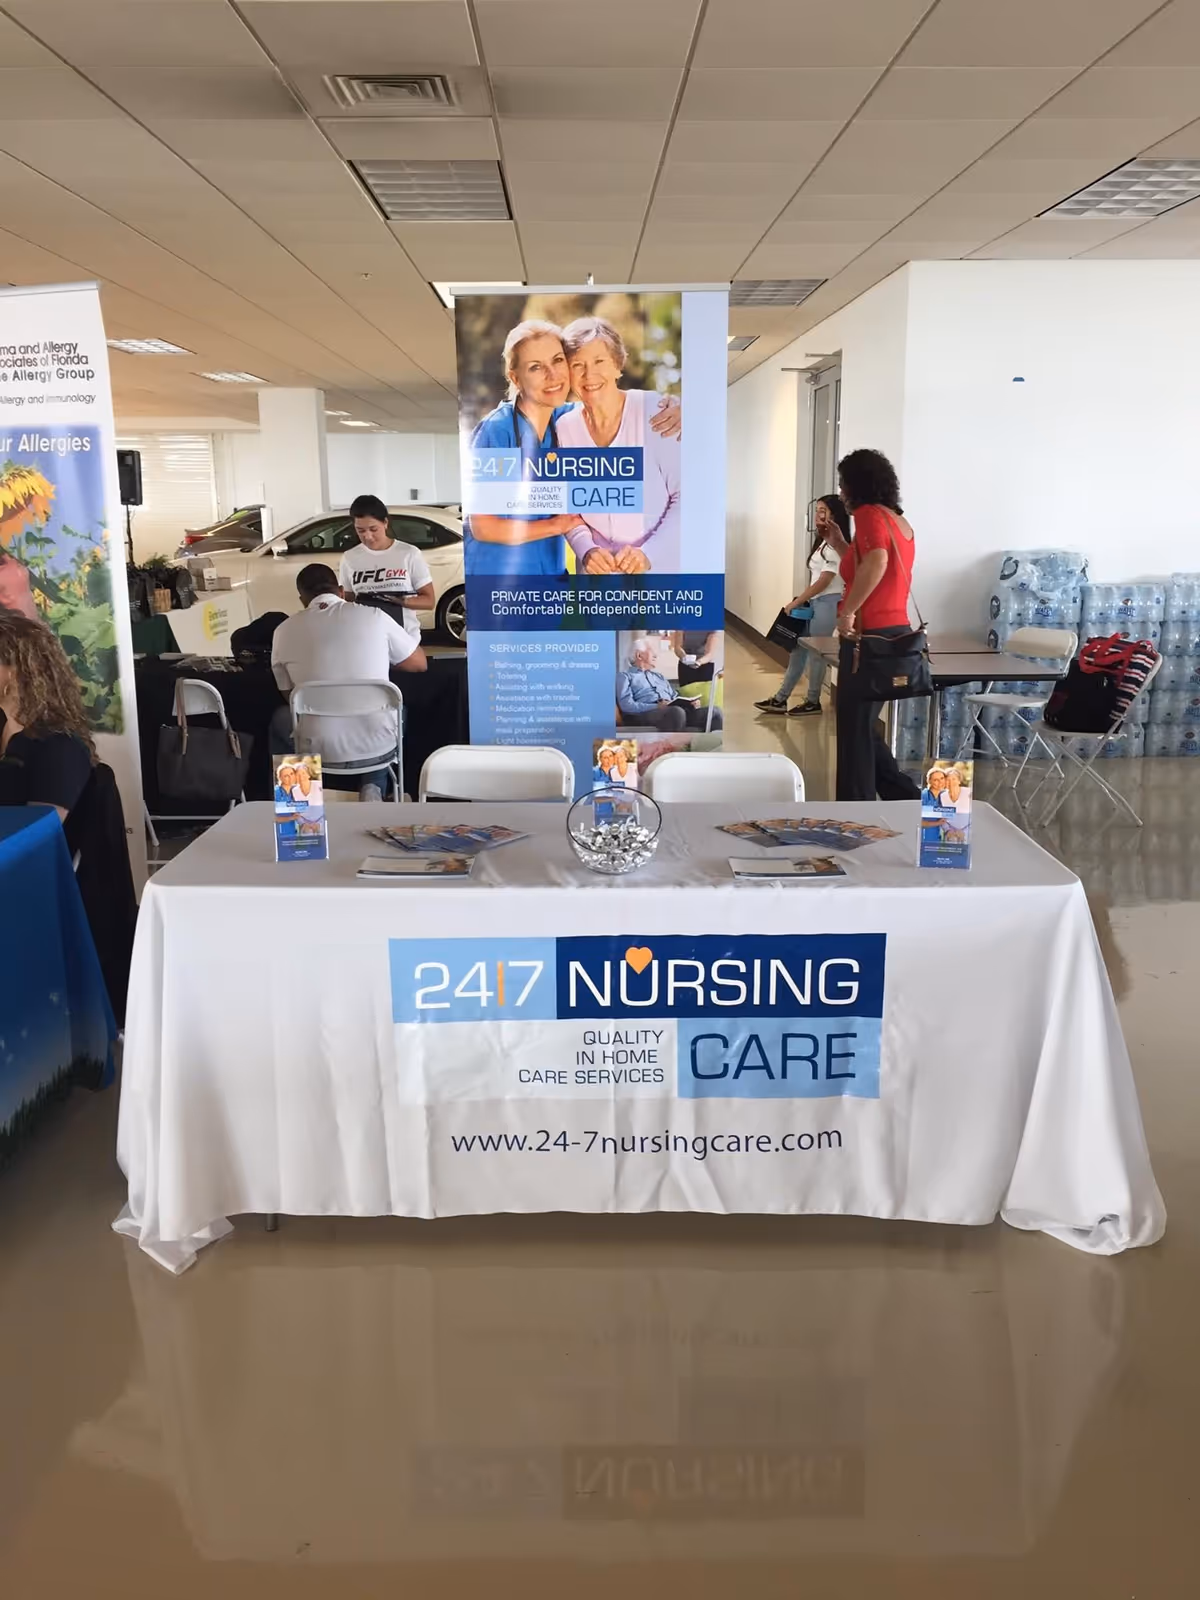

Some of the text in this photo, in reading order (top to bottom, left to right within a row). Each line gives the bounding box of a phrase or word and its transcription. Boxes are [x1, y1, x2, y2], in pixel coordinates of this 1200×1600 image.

[19, 342, 40, 355] and
[43, 341, 78, 355] Allergy
[40, 354, 49, 367] of
[51, 353, 89, 367] Florida
[12, 369, 52, 384] Allergy
[56, 367, 95, 381] Group
[27, 394, 44, 404] and
[18, 433, 91, 457] Allergies
[525, 457, 635, 477] NURSING
[530, 486, 562, 494] QUALITY
[571, 487, 635, 507] CARE
[353, 568, 407, 585] UFC GYM
[491, 590, 704, 602] PRIVATE CARE FOR CONFIDENT AND
[491, 603, 703, 617] Comfortable Independent Living
[489, 643, 599, 653] SERVICES PROVIDED
[568, 958, 861, 1008] NURSING
[583, 1030, 664, 1045] QUALITY
[576, 1049, 658, 1065] IN HOME
[690, 1032, 857, 1081] CARE
[518, 1068, 665, 1084] CARE SERVICES
[451, 1129, 843, 1160] www.24-7nursingcare.com
